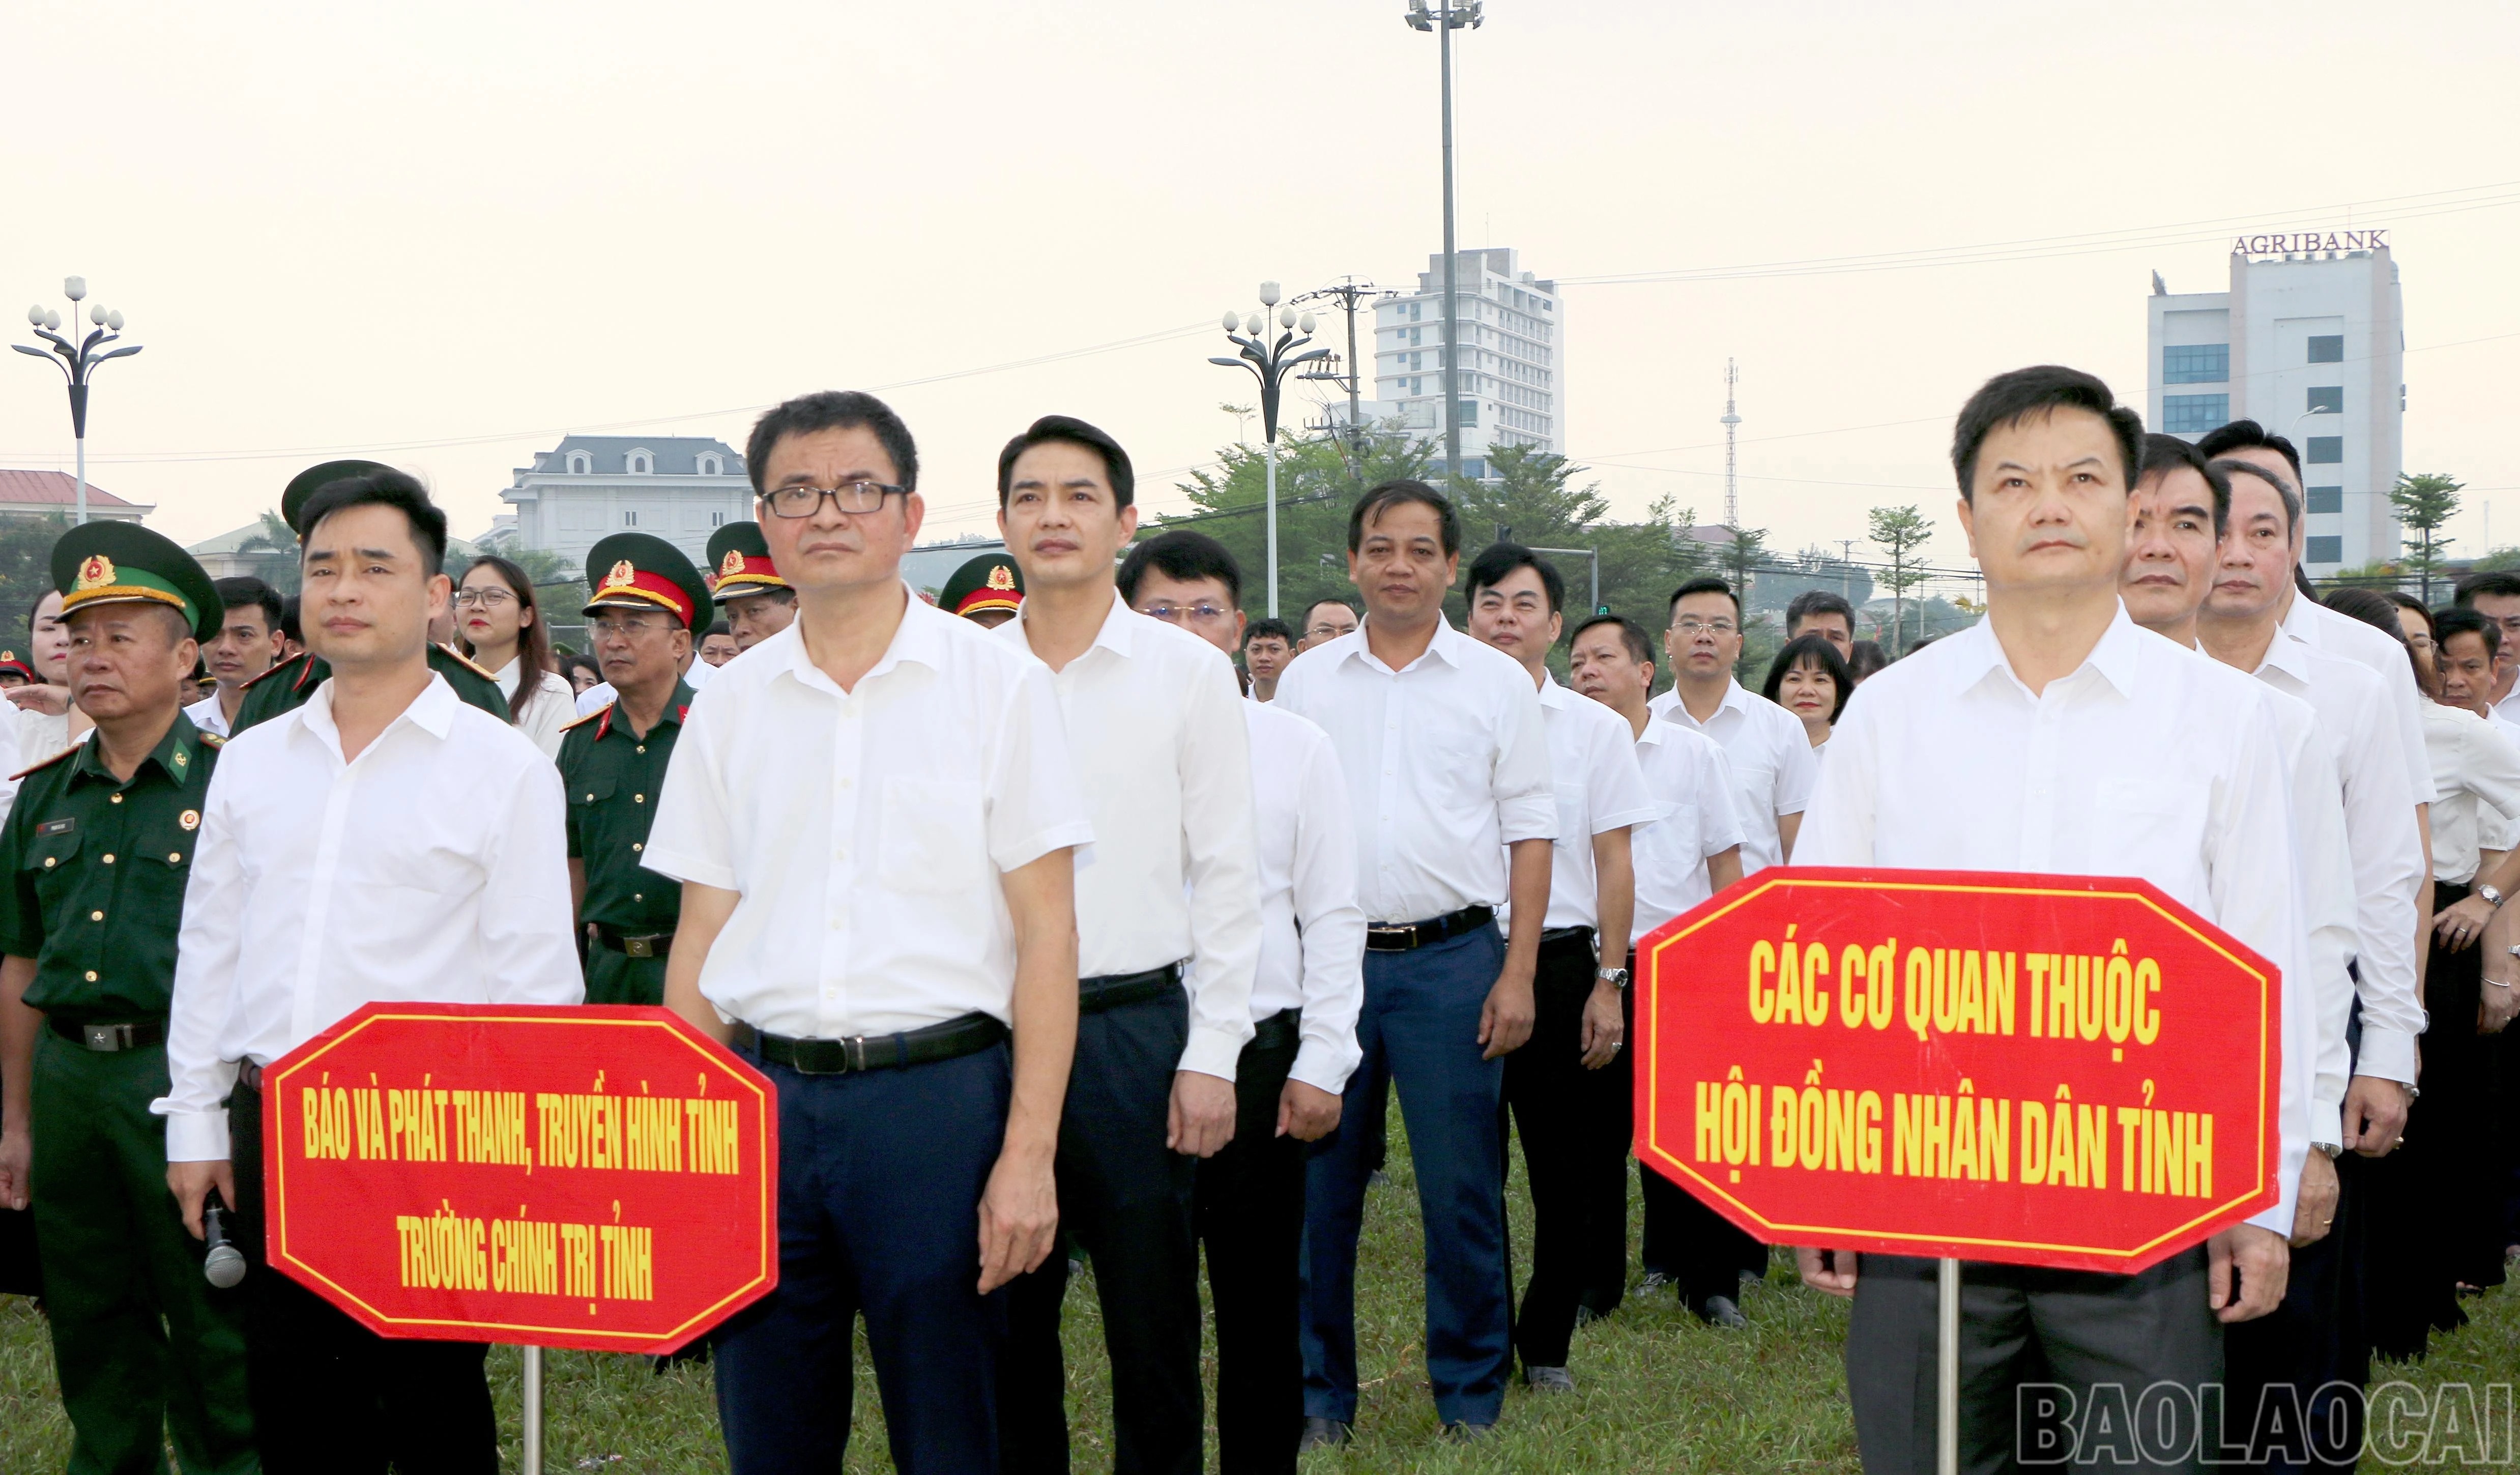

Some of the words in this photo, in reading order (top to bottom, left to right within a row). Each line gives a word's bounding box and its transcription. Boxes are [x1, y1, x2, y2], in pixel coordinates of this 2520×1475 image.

[2231, 230, 2389, 254] AGRIBANK
[1748, 923, 1830, 1027] CÁC
[1840, 937, 1897, 1030] CƠ
[1904, 946, 2016, 1042] QUAN
[2025, 938, 2161, 1062] THUỘC
[302, 1072, 350, 1160] BÁO
[352, 1072, 388, 1161] VÀ
[389, 1073, 448, 1162] PHÁT
[452, 1090, 532, 1175] THANH,
[537, 1069, 622, 1170] TRUYỀN
[626, 1080, 682, 1172] HÌNH
[685, 1072, 739, 1175] TỈNH
[1695, 1065, 1761, 1183] HỘI
[1770, 1059, 1882, 1174] ĐỒNG
[1892, 1078, 2010, 1182] NHÂN
[2020, 1084, 2107, 1189] DÂN
[2117, 1079, 2213, 1199] TỈNH
[396, 1198, 487, 1291] TRƯỜNG
[491, 1204, 558, 1295] CHÍNH
[561, 1223, 596, 1316] TRỊ
[600, 1199, 653, 1301] TỈNH
